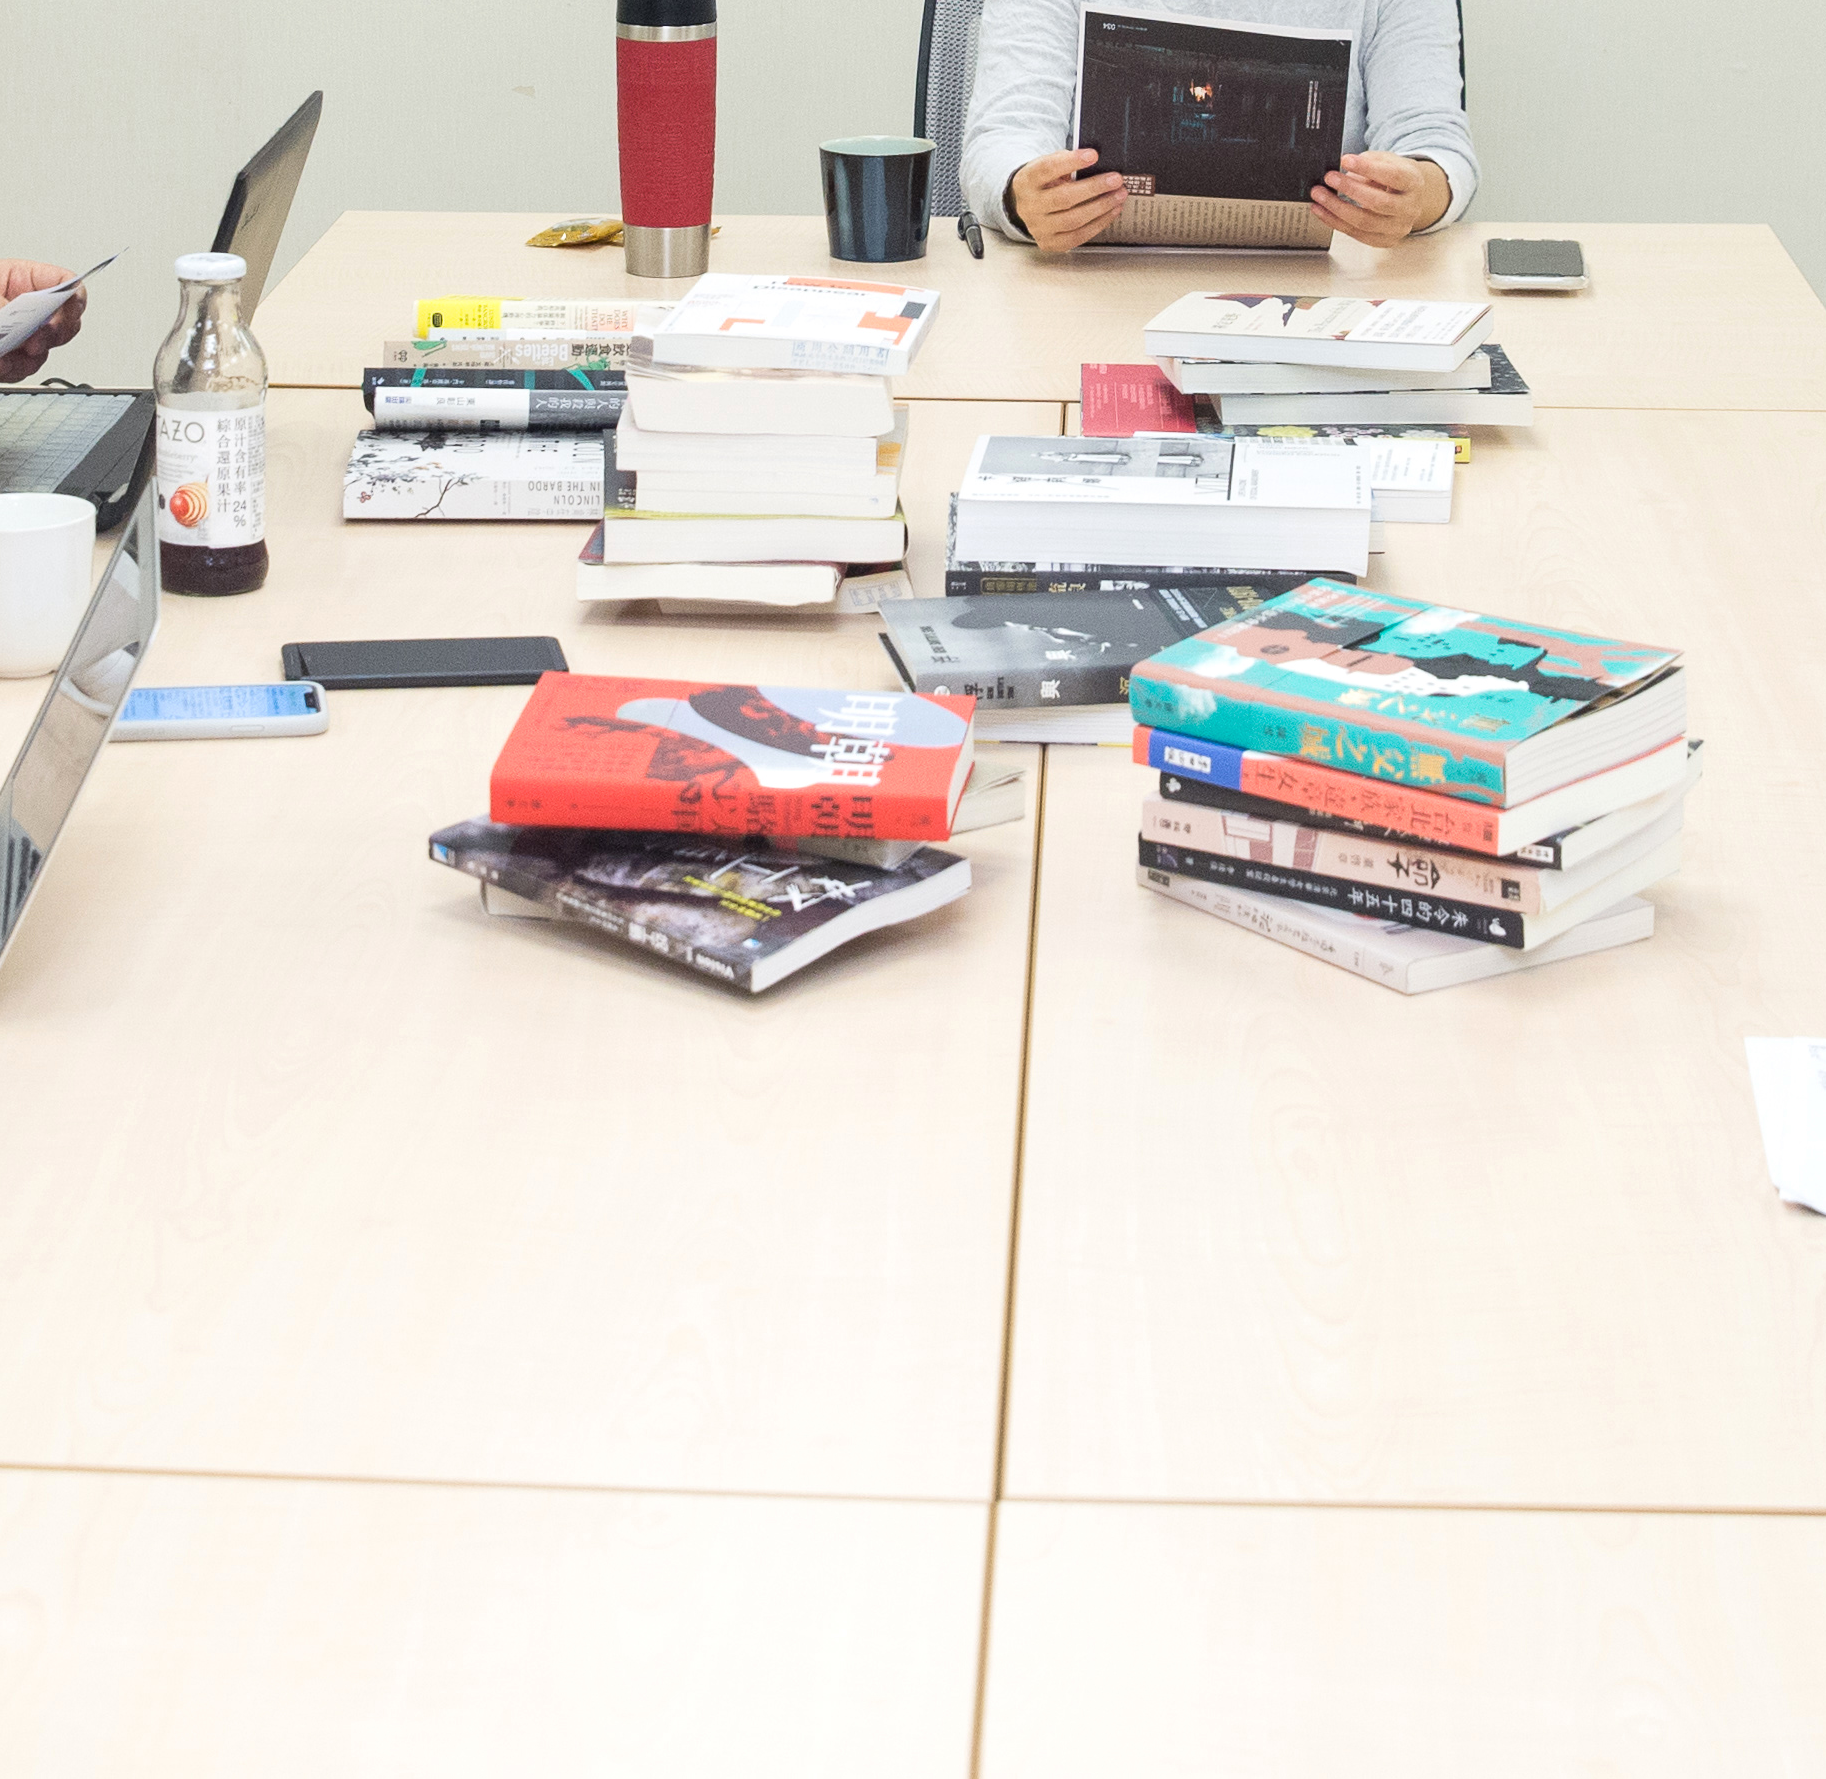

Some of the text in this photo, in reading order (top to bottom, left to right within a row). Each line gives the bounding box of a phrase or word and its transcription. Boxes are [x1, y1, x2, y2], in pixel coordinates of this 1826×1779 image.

[515, 341, 569, 360] Beetles
[572, 343, 630, 357] 飲食運動
[535, 396, 626, 410] 的人與殺我的人
[216, 418, 231, 514] 綜合還原果汁
[527, 479, 601, 492] IN THE BARDO
[552, 494, 601, 506] LINCOLN
[1040, 678, 1061, 699] 與
[811, 694, 904, 786] 明朝
[1300, 726, 1447, 785] 無父之城
[1347, 887, 1468, 926] 朱令的四十五年
